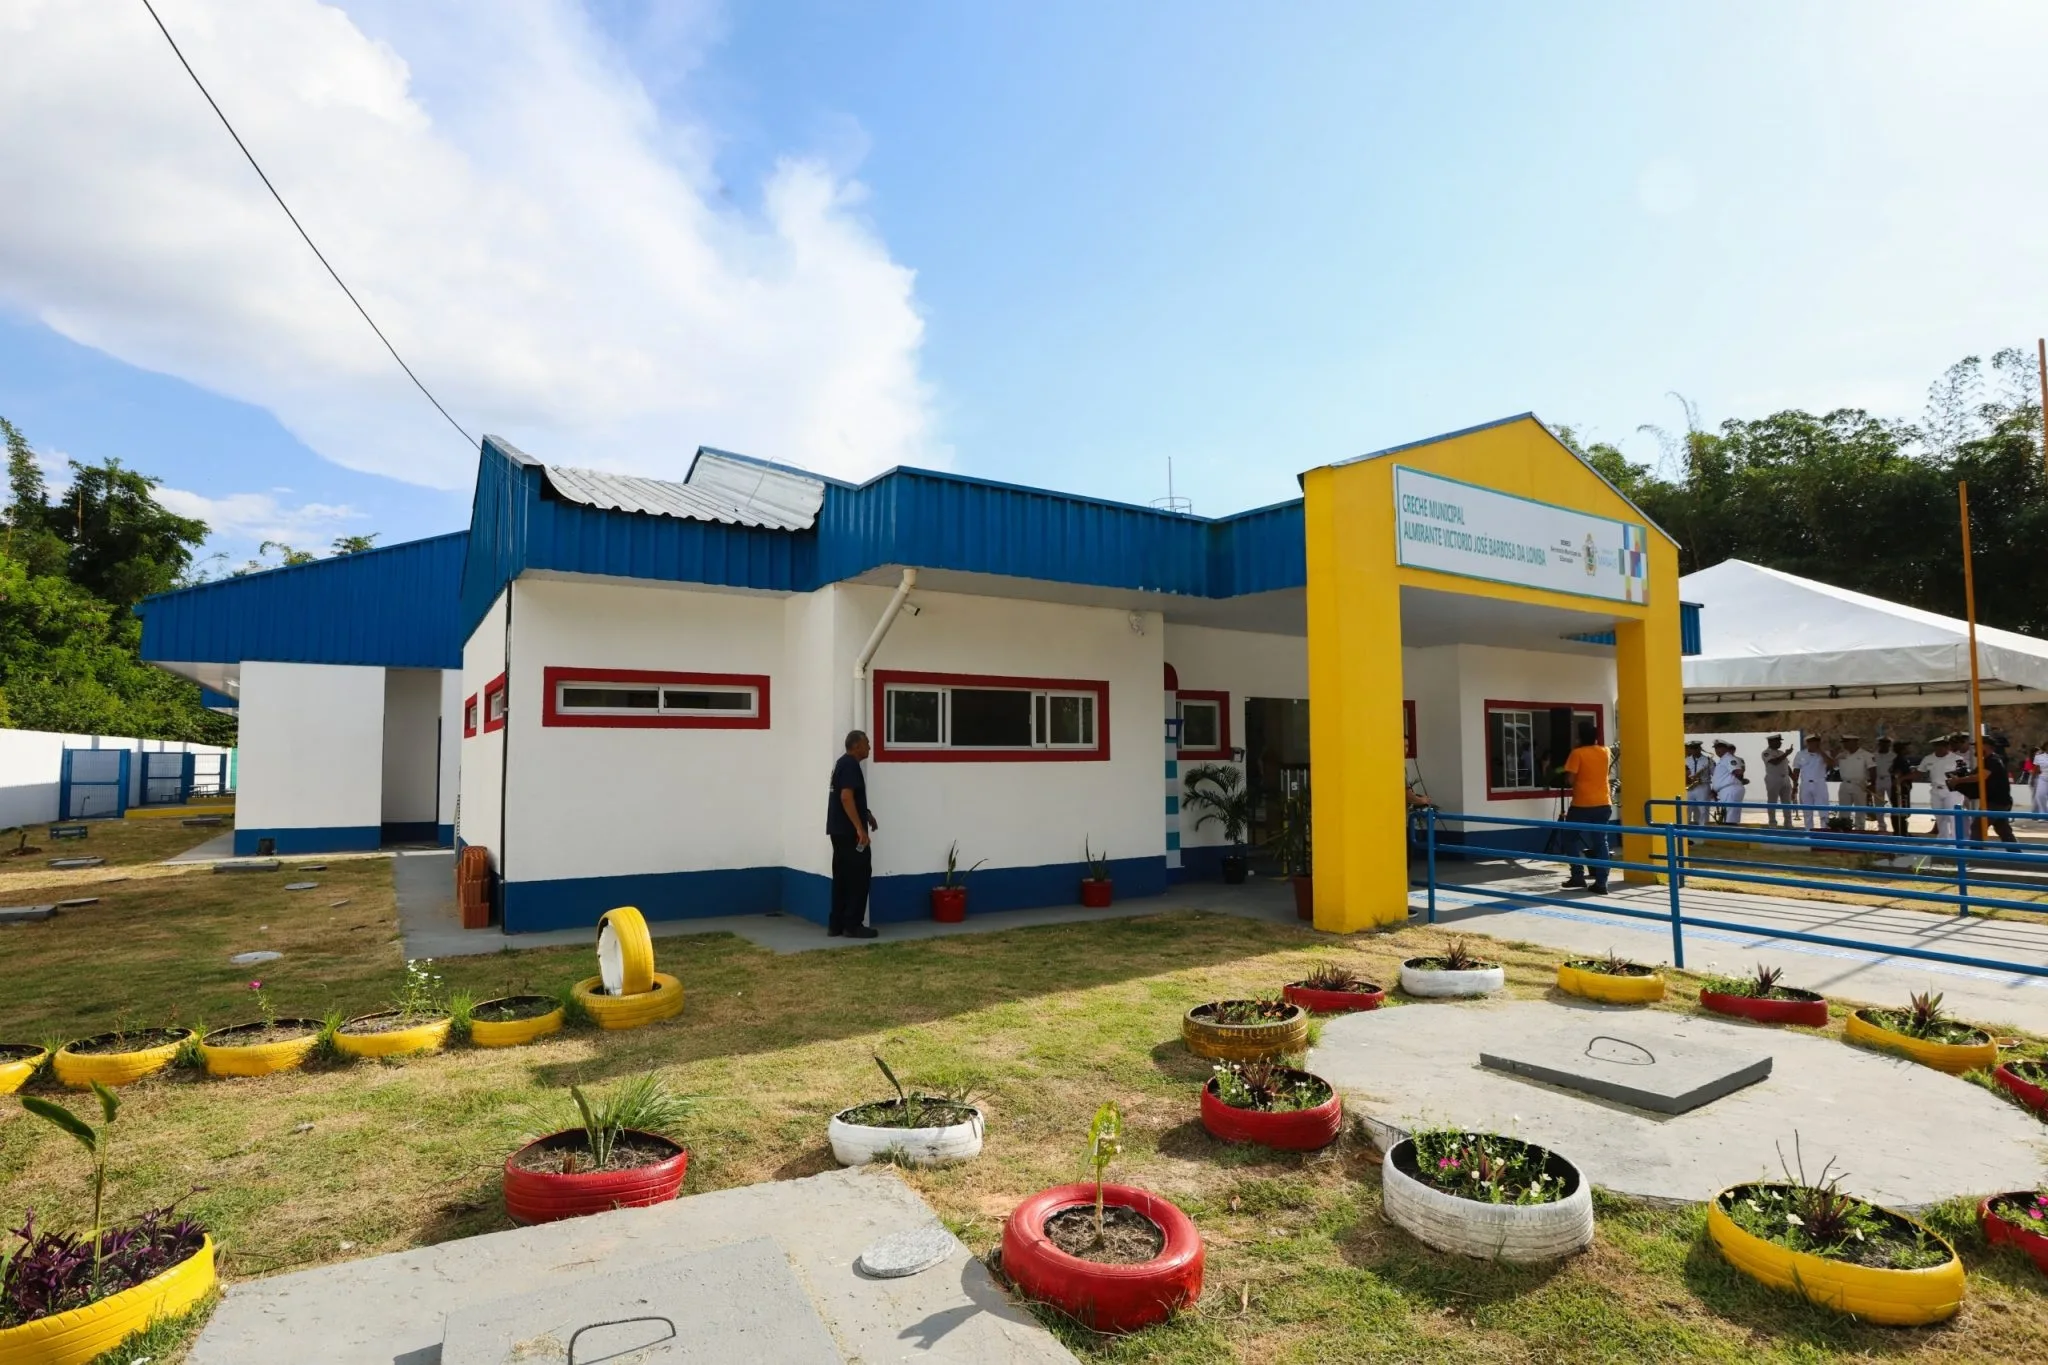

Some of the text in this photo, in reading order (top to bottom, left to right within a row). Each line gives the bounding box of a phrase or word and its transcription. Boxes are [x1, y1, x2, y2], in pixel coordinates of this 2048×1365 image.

[1402, 494, 1465, 525] CRECHE MUNICIPAL
[1404, 521, 1443, 546] ALMIRANTE
[1473, 532, 1488, 554] JOSÉ
[1489, 538, 1516, 560] BARBOSA
[1516, 544, 1526, 563] DA
